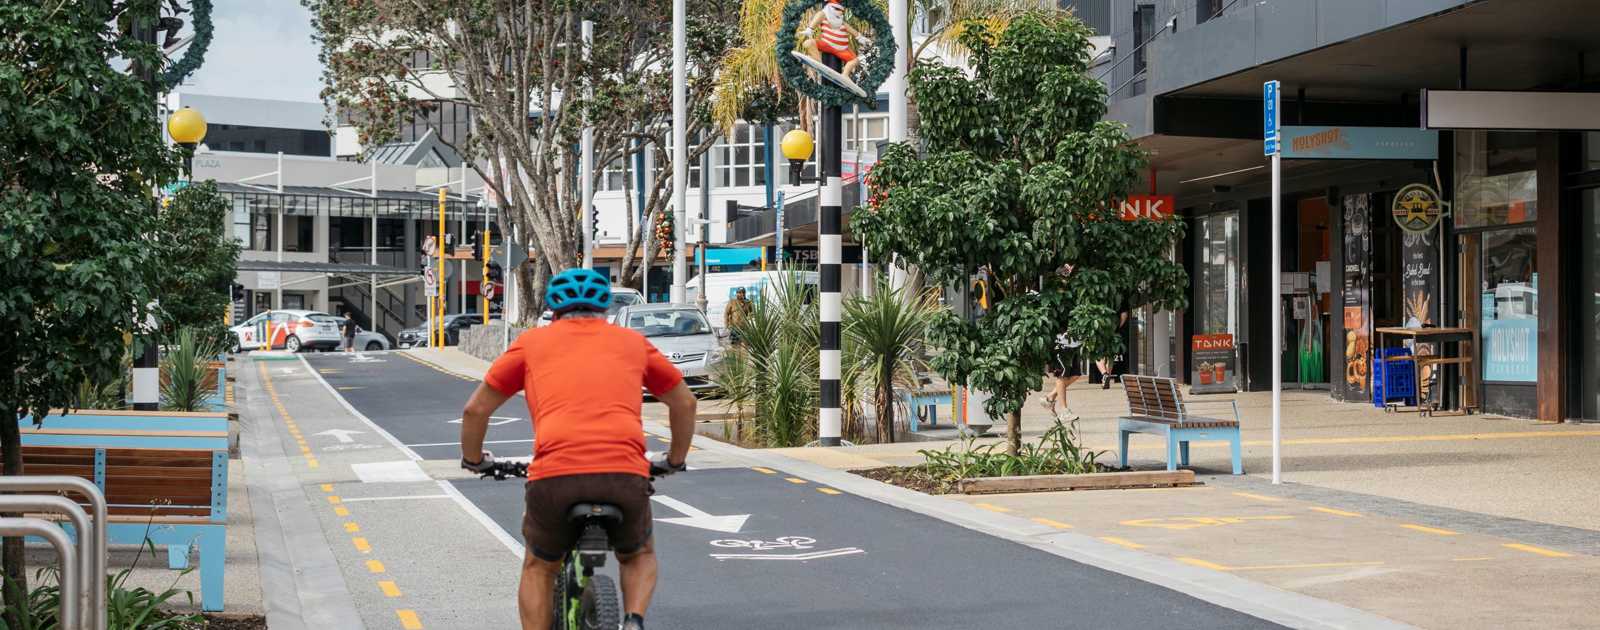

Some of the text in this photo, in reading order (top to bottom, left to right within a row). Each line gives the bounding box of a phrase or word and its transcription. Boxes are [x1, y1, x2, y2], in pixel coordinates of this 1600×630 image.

[195, 160, 222, 168] PLAZA
[1120, 199, 1164, 218] NK
[1194, 339, 1231, 349] TANK
[1491, 327, 1530, 362] HOLYSHOT
